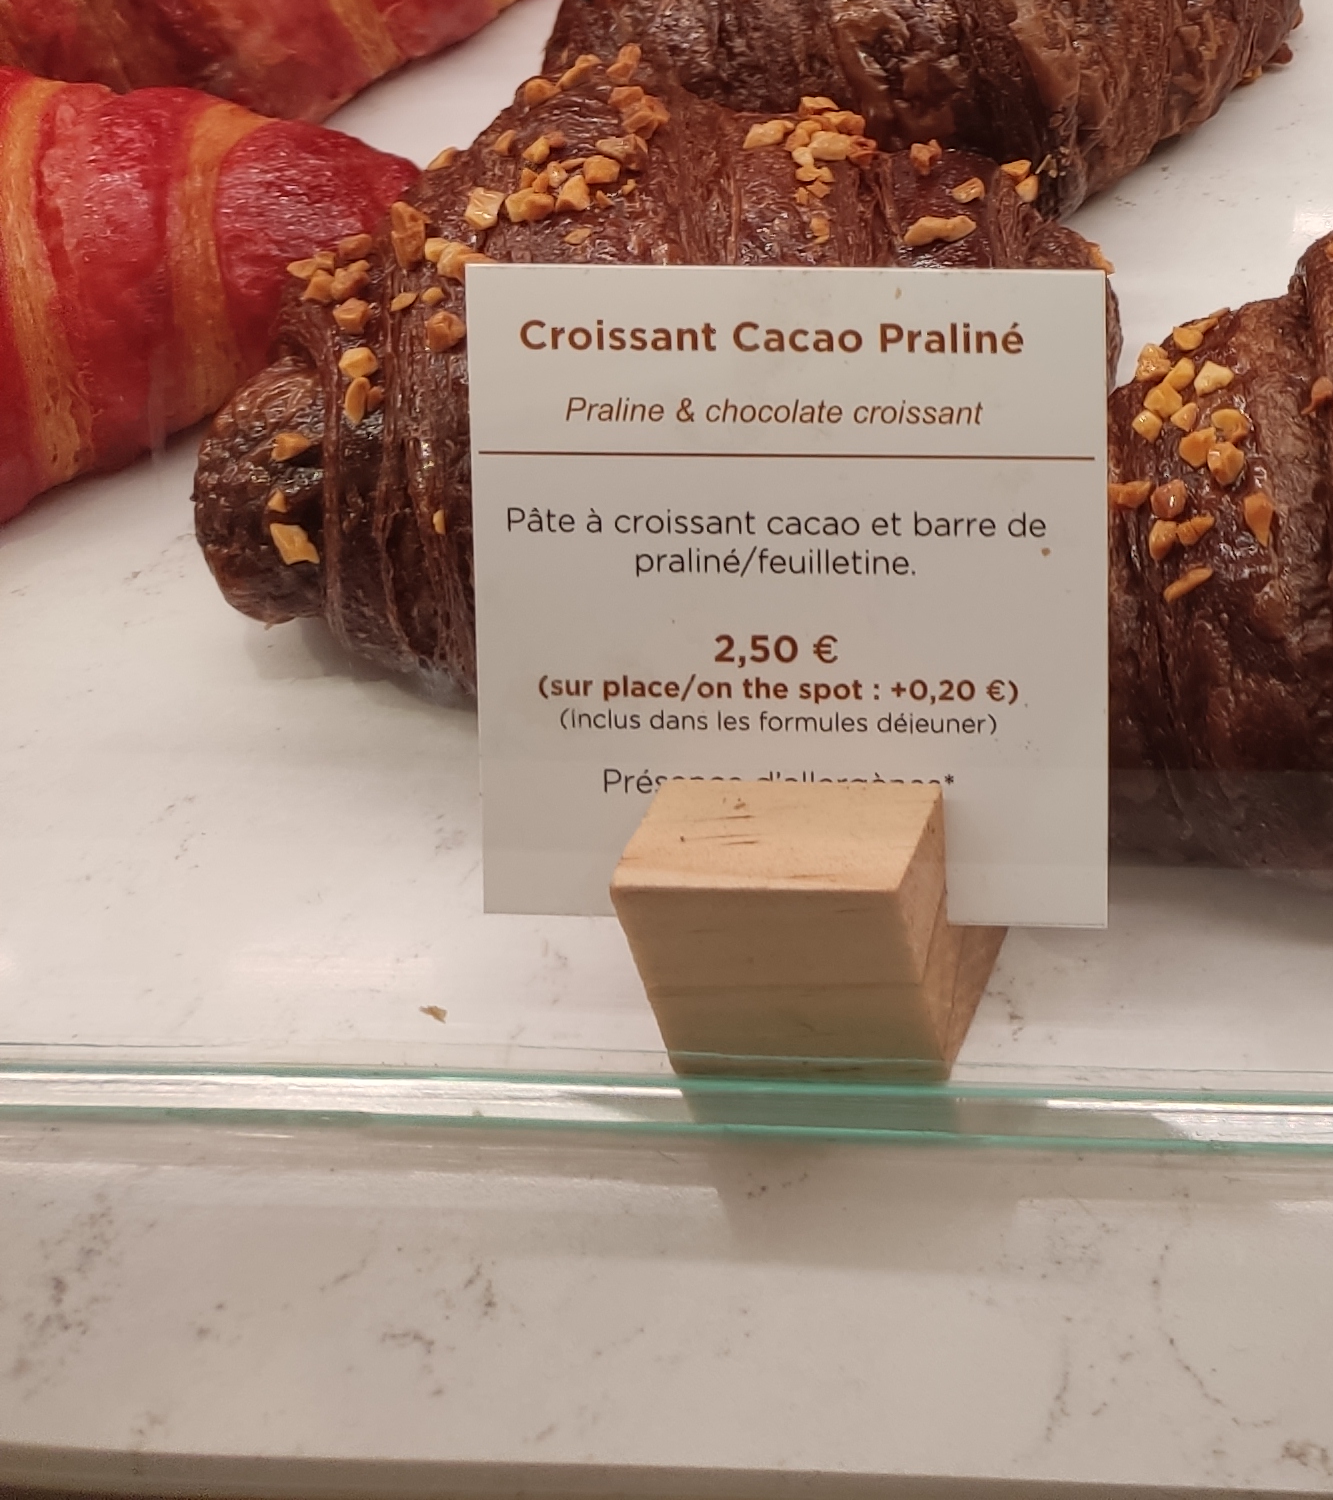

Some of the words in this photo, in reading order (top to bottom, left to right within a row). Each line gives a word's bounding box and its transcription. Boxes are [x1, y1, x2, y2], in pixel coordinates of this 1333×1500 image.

[519, 318, 717, 352] Croissant
[732, 320, 864, 354] Cacao
[879, 321, 1024, 355] Praliné
[565, 396, 665, 423] Praline
[675, 397, 695, 424] &
[705, 397, 844, 425] chocolate
[853, 399, 984, 426] croissant
[506, 506, 576, 534] Pâte
[586, 507, 603, 534] à
[614, 508, 756, 536] croissant
[766, 515, 861, 537] cacao
[871, 511, 903, 537] et
[913, 510, 997, 538] barre
[1007, 511, 1047, 539] de
[635, 545, 916, 578] praliné/feuilletine.
[714, 633, 799, 669] 2,50
[812, 634, 839, 665] €
[538, 674, 594, 700] (sur
[602, 673, 733, 703] place/on
[742, 676, 789, 700] the
[798, 679, 863, 705] spot
[873, 683, 880, 701] :
[890, 678, 976, 706] +0,20
[985, 678, 1019, 706] €)
[649, 709, 709, 731] dans
[717, 709, 751, 732] les
[759, 710, 869, 733] formules
[876, 711, 998, 736] déjeuner)
[603, 768, 741, 794] Prés
